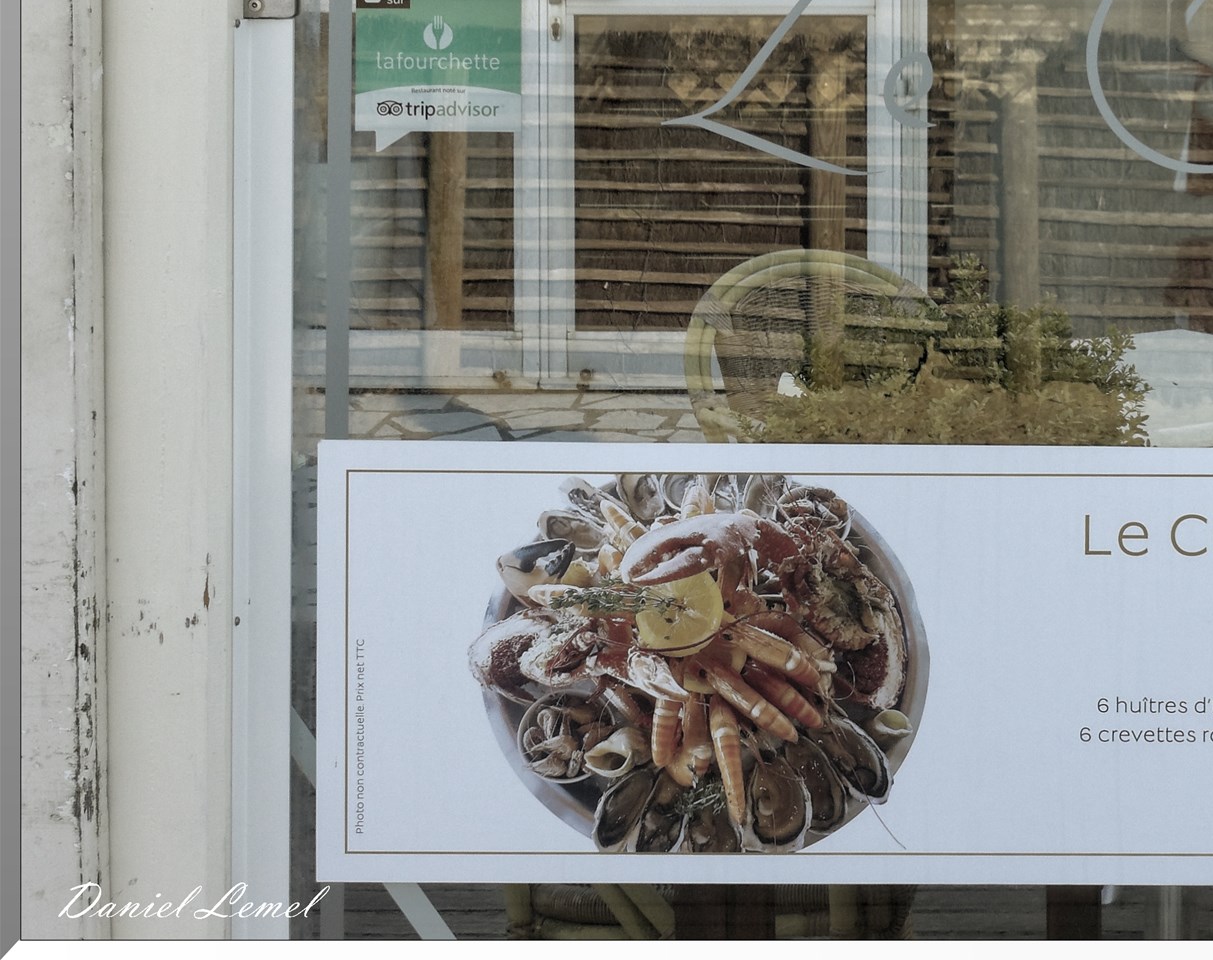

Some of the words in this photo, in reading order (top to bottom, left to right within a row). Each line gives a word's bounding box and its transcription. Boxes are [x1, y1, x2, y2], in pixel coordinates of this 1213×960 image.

[376, 51, 501, 71] lafourchette
[405, 101, 500, 121] tripadvisor
[1084, 514, 1149, 557] Le
[355, 639, 365, 660] TTC
[356, 662, 365, 680] net
[355, 682, 365, 701] Prix
[1097, 698, 1110, 714] 6
[1115, 696, 1188, 714] huîtres
[1079, 726, 1092, 743] 6
[1098, 727, 1197, 743] crevettes
[357, 778, 365, 800] non
[355, 801, 365, 835] Photo
